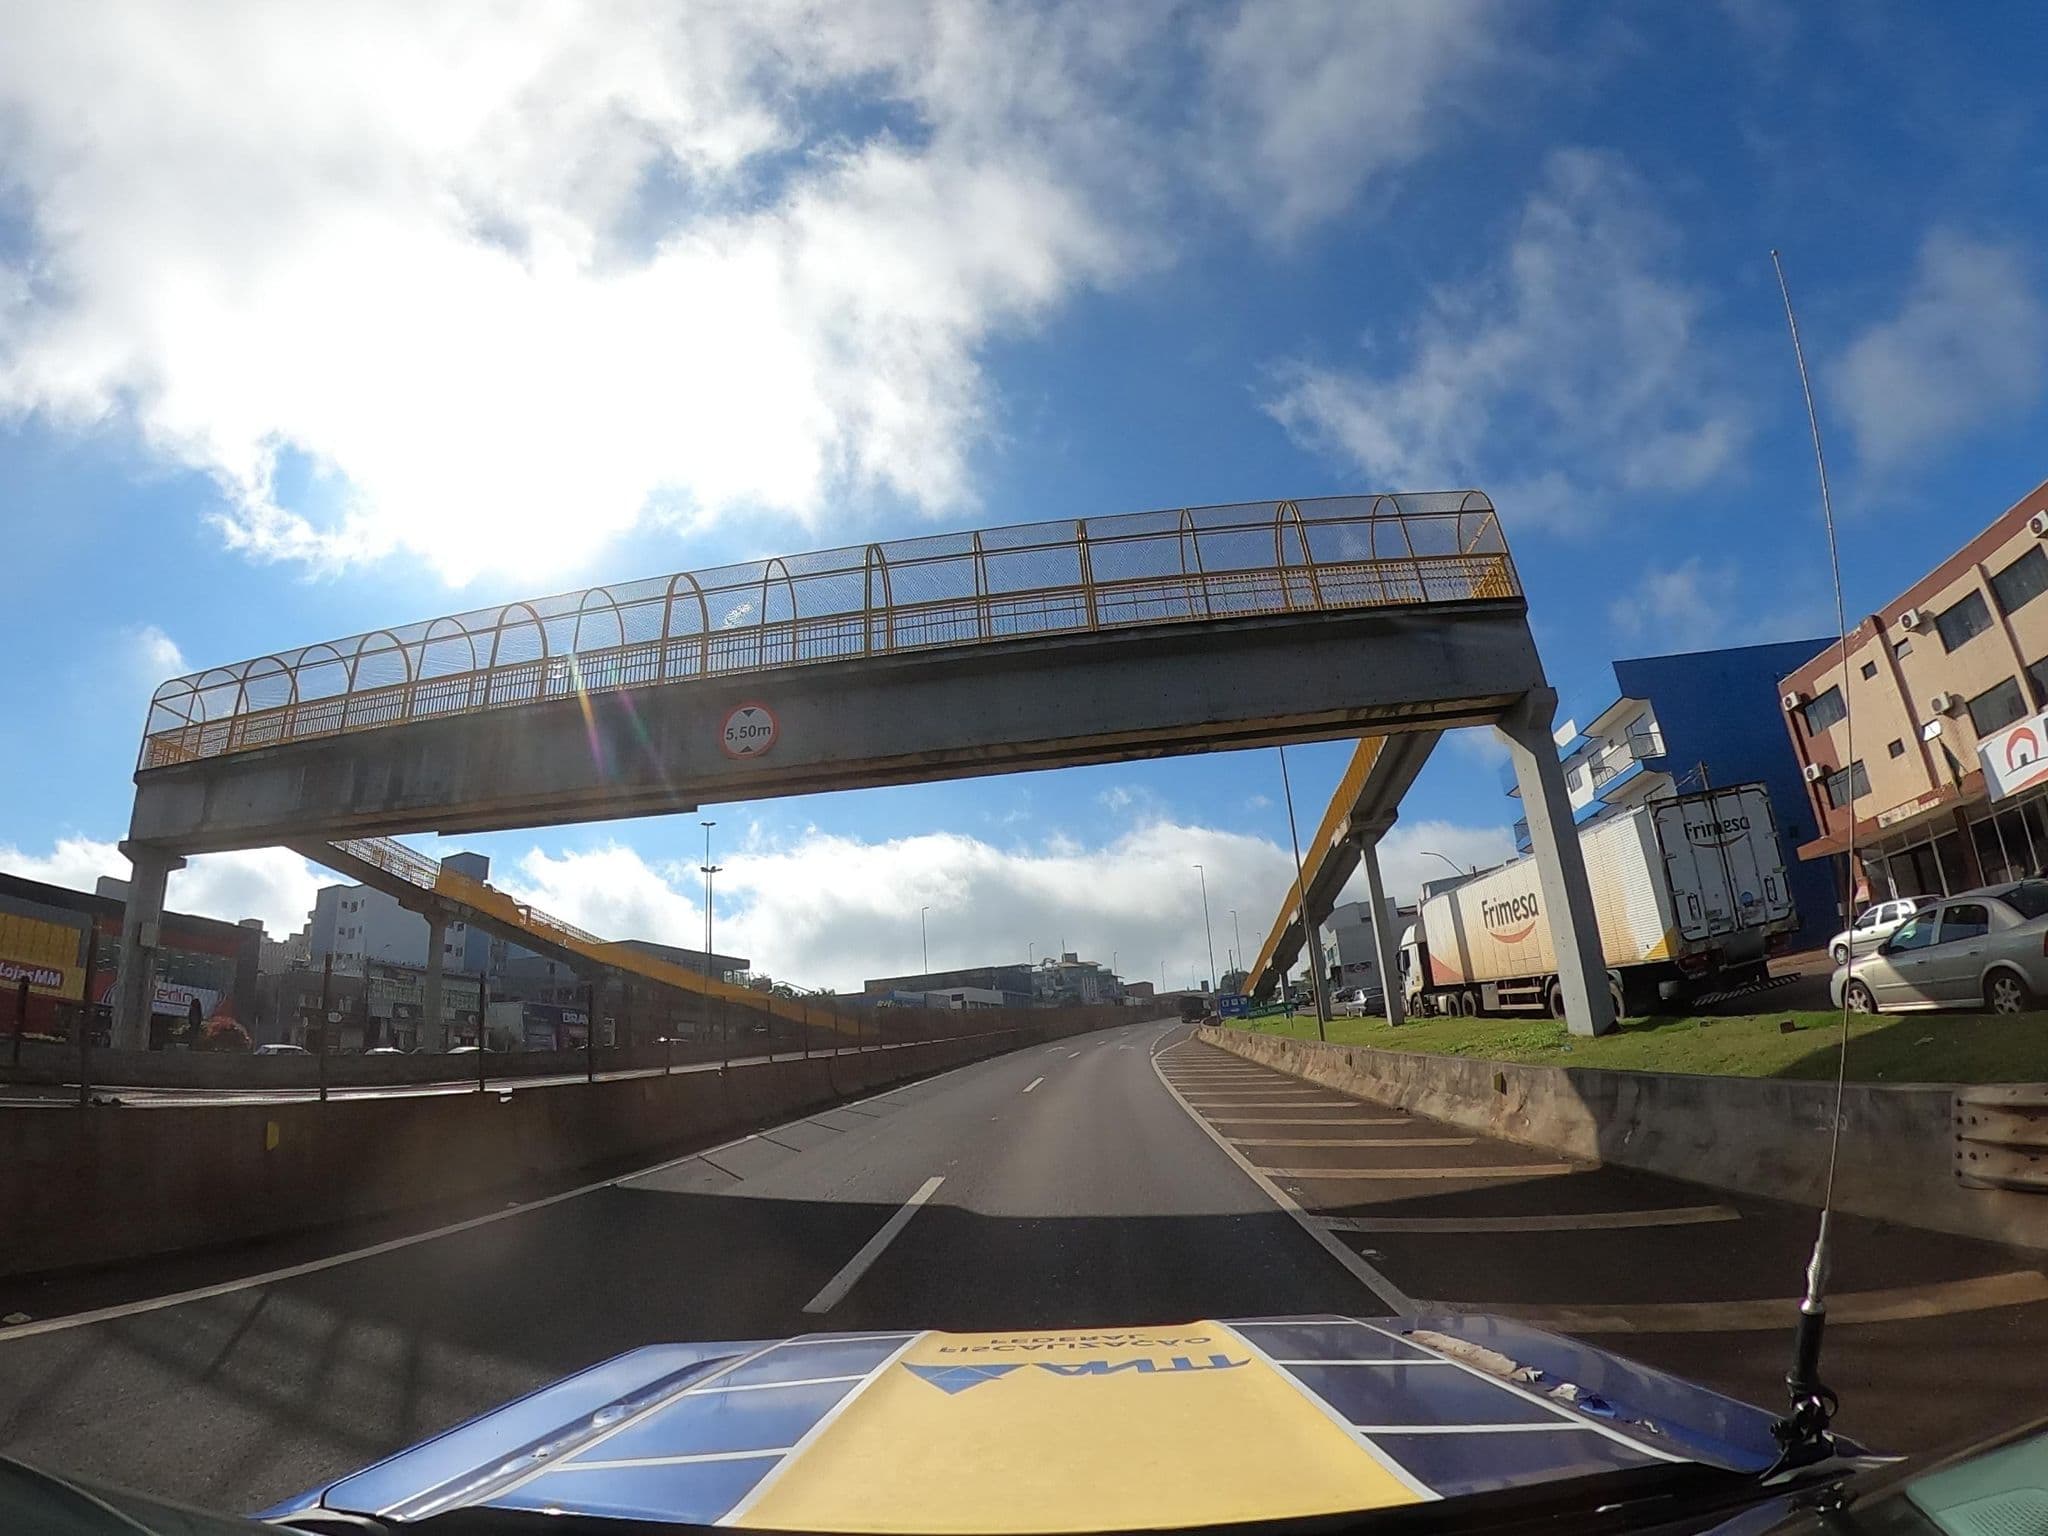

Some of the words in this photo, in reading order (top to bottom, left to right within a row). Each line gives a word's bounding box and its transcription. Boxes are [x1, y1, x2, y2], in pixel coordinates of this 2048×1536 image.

[726, 725, 771, 741] 5,50m
[1683, 816, 1751, 841] Frimesa
[1481, 893, 1539, 929] Frimesa
